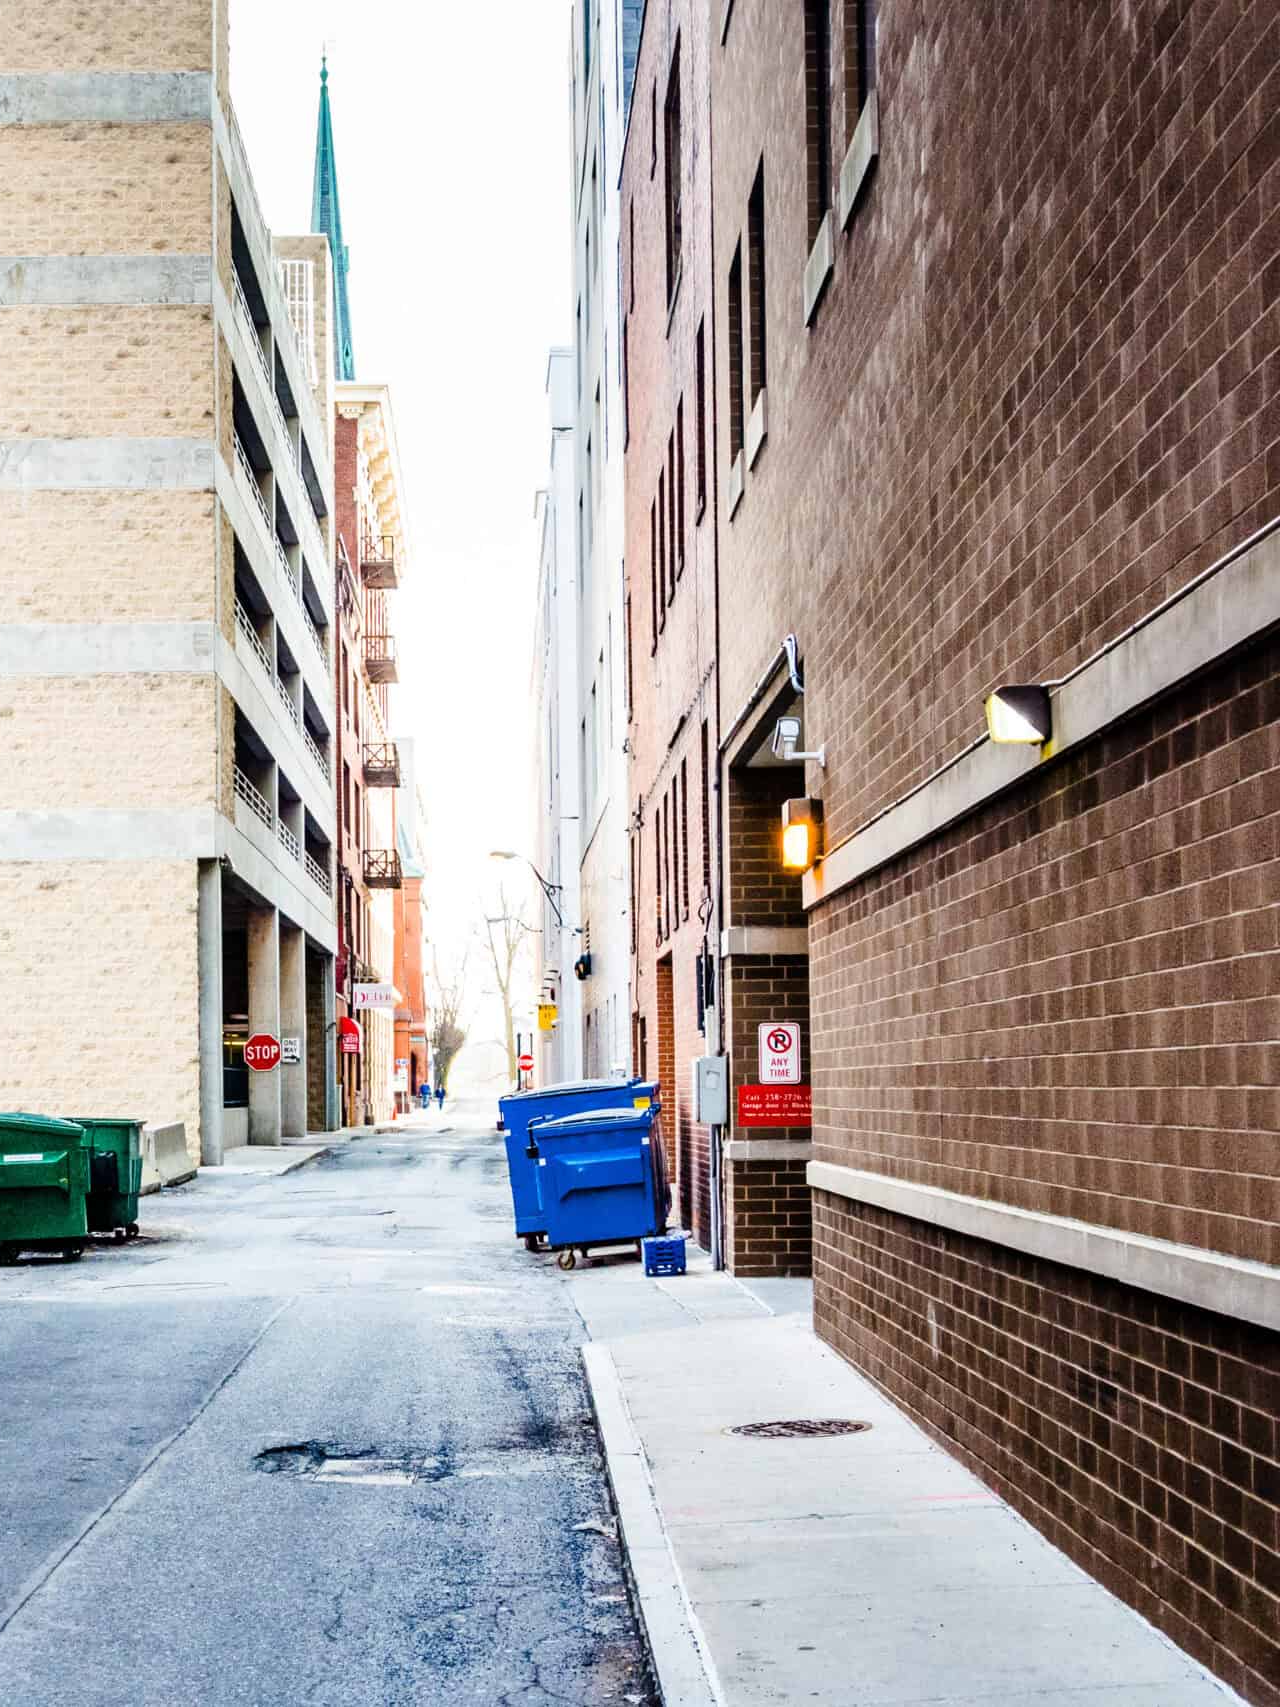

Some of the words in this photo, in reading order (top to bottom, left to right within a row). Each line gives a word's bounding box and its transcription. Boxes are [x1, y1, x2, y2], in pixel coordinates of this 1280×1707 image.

[247, 1045, 279, 1060] STOP
[770, 1058, 789, 1066] ANY
[769, 1069, 790, 1077] TIME
